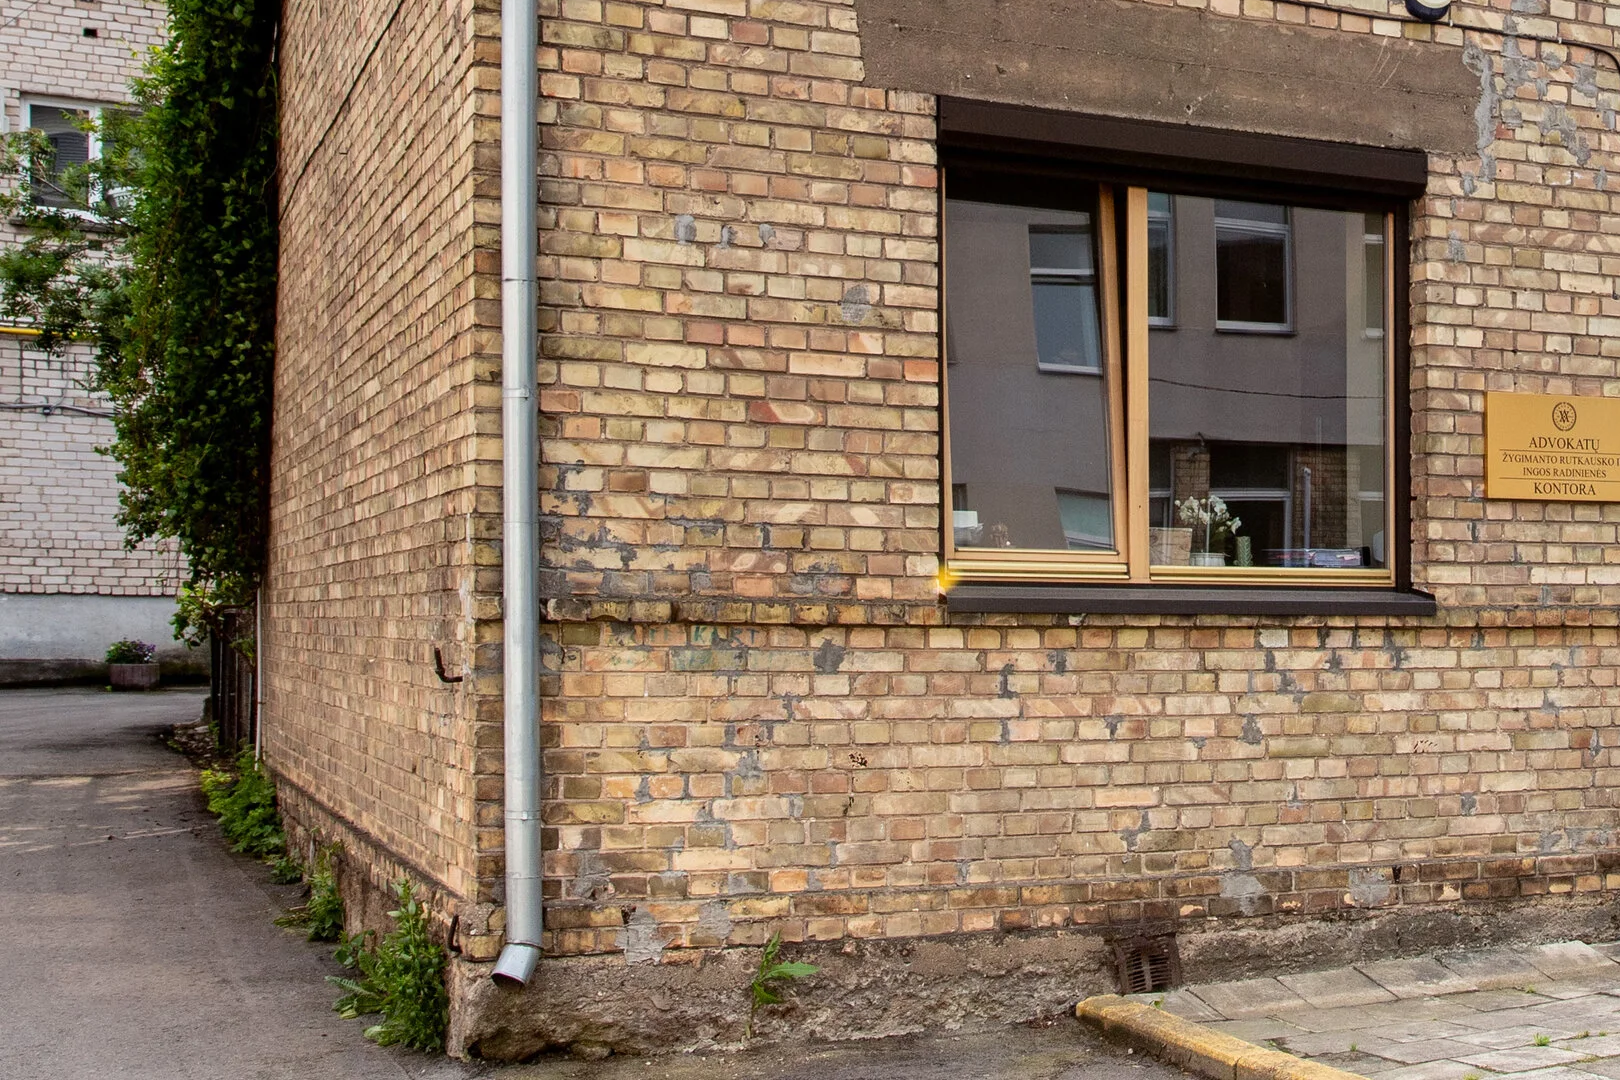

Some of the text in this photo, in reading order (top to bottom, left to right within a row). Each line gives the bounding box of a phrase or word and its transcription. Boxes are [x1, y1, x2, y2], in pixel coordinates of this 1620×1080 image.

[1529, 437, 1600, 453] ADVOKATŲ
[1502, 453, 1558, 465] ŽYGIMANTO
[1559, 456, 1615, 467] RUTKAUSKO
[1522, 467, 1551, 477] INGOS
[1534, 482, 1597, 496] KONTORA
